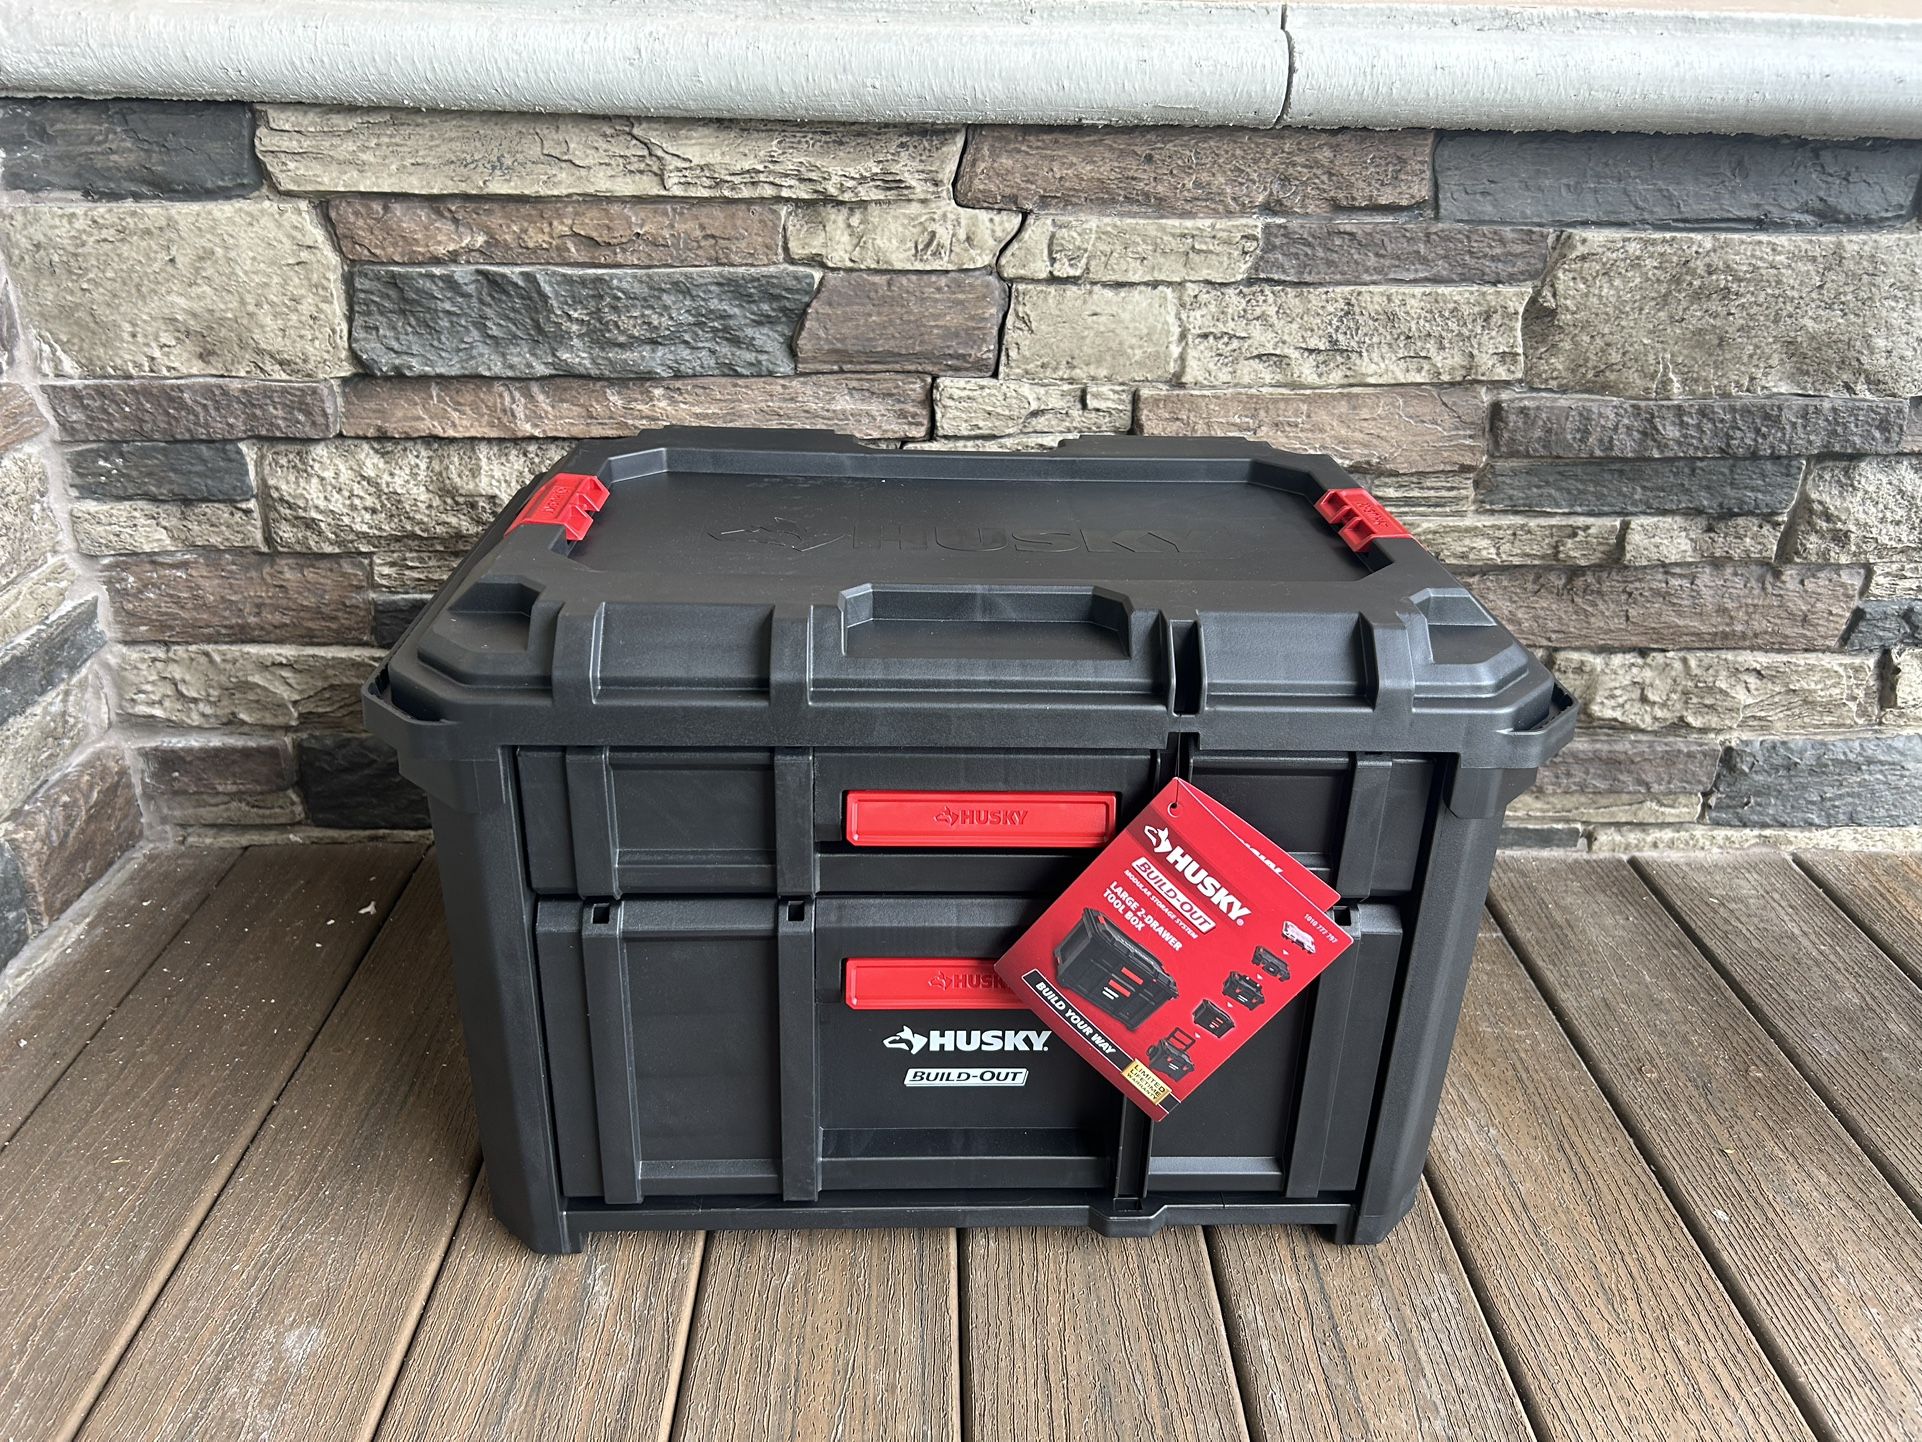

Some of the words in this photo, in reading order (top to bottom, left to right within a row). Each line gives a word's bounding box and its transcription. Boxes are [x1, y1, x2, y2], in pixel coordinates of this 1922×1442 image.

[852, 525, 1209, 553] HUSKY
[960, 810, 1028, 825] HUSKY
[1123, 869, 1152, 898] MODULAR
[1149, 894, 1176, 921] STORAGE
[1175, 916, 1199, 939] SYSTEM
[1136, 861, 1211, 927] BUILD-OUT
[1102, 888, 1124, 914] TOOL
[1123, 909, 1146, 932] BOX
[1109, 880, 1140, 911] LARGE
[1137, 907, 1183, 952] 2-DRAWER
[953, 973, 1012, 989] HUSK
[1035, 981, 1066, 1011] BUILD
[1064, 1008, 1094, 1036] YOUR
[1090, 1033, 1116, 1054] WAY
[912, 1070, 1023, 1083] BUILD-OUT
[1129, 1068, 1161, 1098] LIFETIME
[1134, 1064, 1166, 1093] LIMITED
